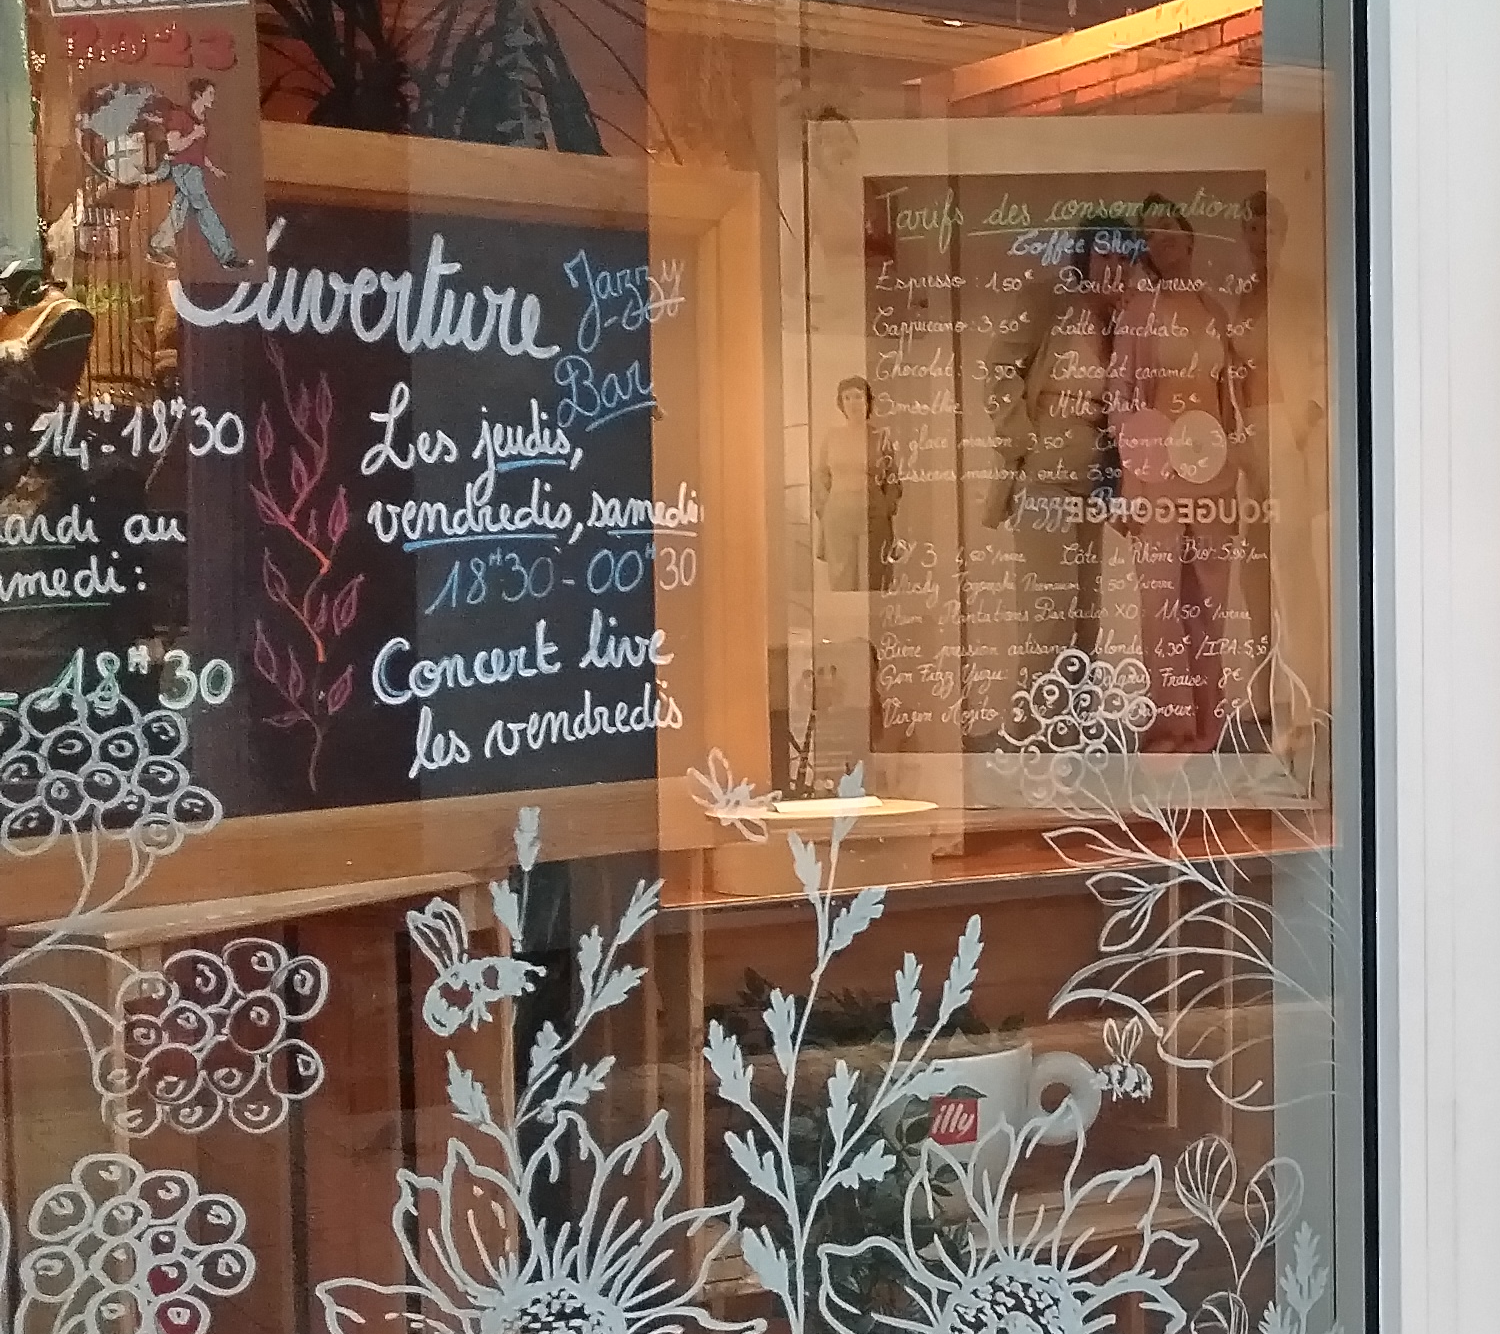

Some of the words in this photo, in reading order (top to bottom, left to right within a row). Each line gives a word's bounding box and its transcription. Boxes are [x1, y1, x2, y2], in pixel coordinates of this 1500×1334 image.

[875, 186, 965, 255] Tarifs
[982, 192, 1031, 227] des
[1044, 187, 1253, 222] consommations
[1006, 228, 1086, 267] Coffee
[1092, 229, 1150, 267] Shop
[562, 248, 687, 353] Jazzy
[1053, 264, 1125, 296] Double
[1136, 276, 1206, 310] espresso
[1050, 306, 1097, 337] Latte
[1101, 308, 1190, 338] Macchiato
[1049, 349, 1129, 381] Chocolat
[554, 354, 654, 428] Bar
[1101, 385, 1148, 414] Shake
[360, 380, 459, 476] Les
[0, 495, 100, 546] ardi
[123, 513, 187, 545] au
[371, 618, 562, 706] Concert
[579, 607, 675, 669] live
[407, 704, 471, 780] les
[484, 679, 684, 759] vendredis
[930, 1102, 975, 1137] illy
